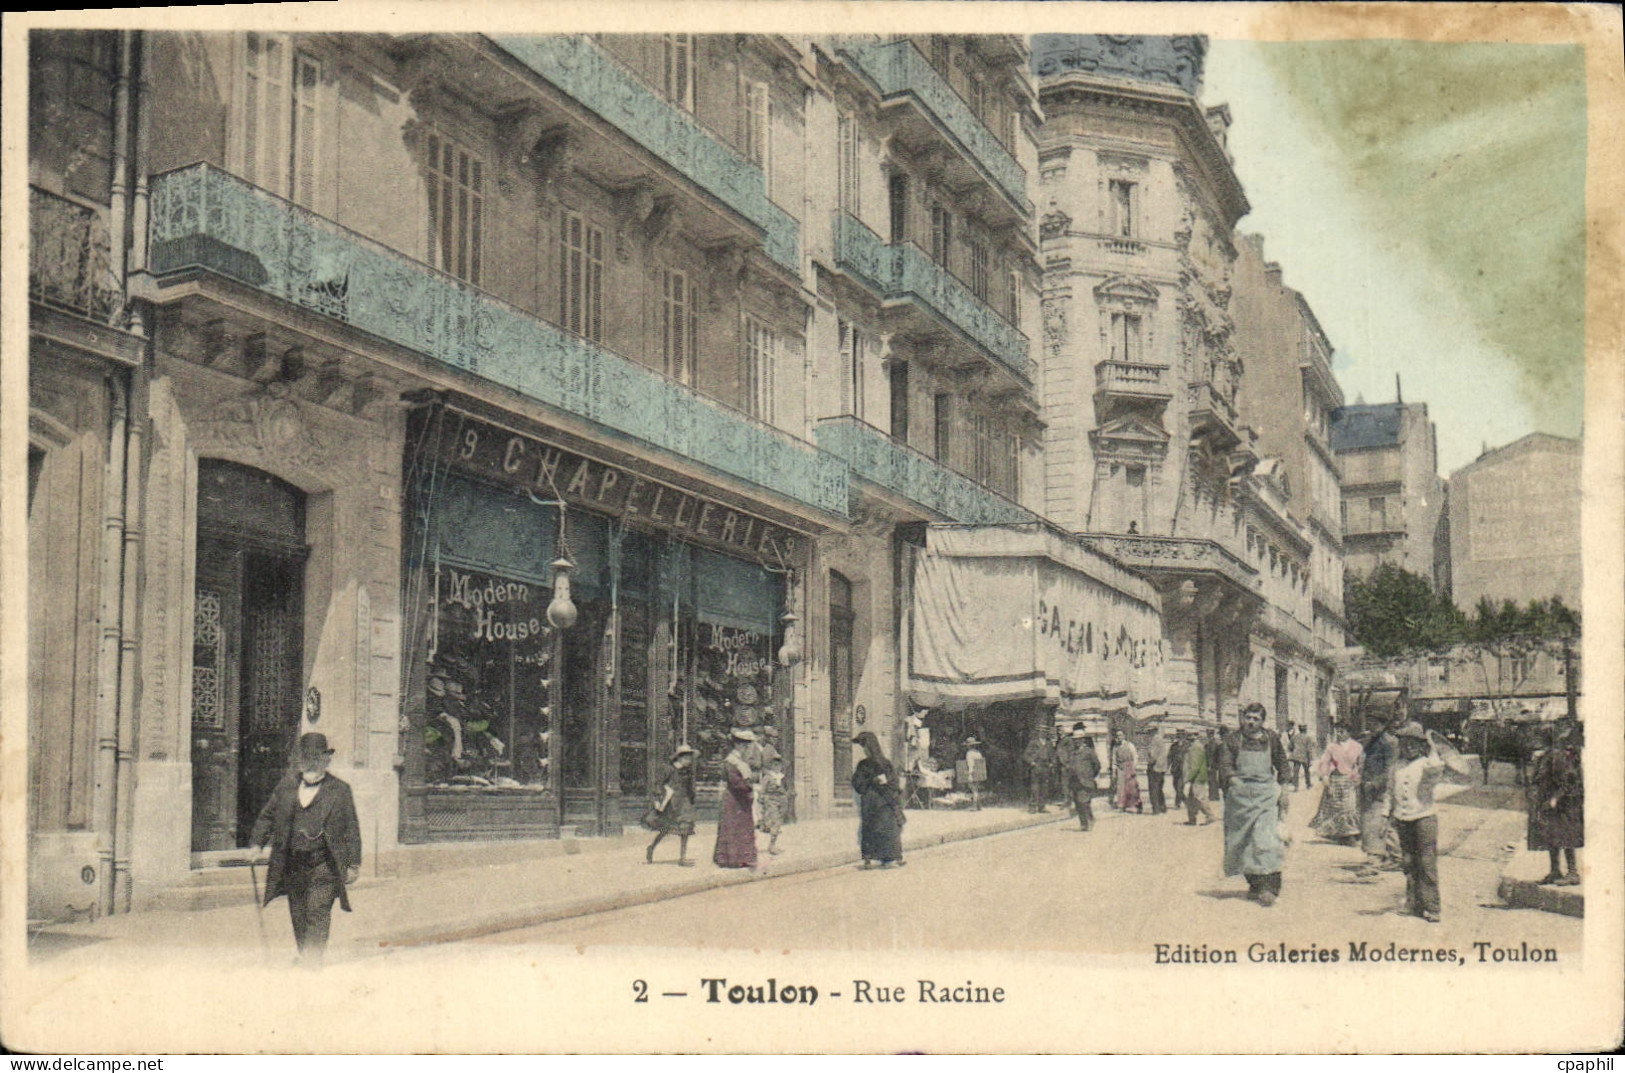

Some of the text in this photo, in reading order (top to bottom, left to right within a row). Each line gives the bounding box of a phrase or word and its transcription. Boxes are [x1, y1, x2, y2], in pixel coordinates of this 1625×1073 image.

[460, 428, 479, 461] 9
[502, 436, 777, 554] CHAPELLERIE
[446, 568, 529, 610] Modern
[472, 608, 541, 643] House
[708, 623, 761, 653] Modern
[724, 651, 767, 677] House
